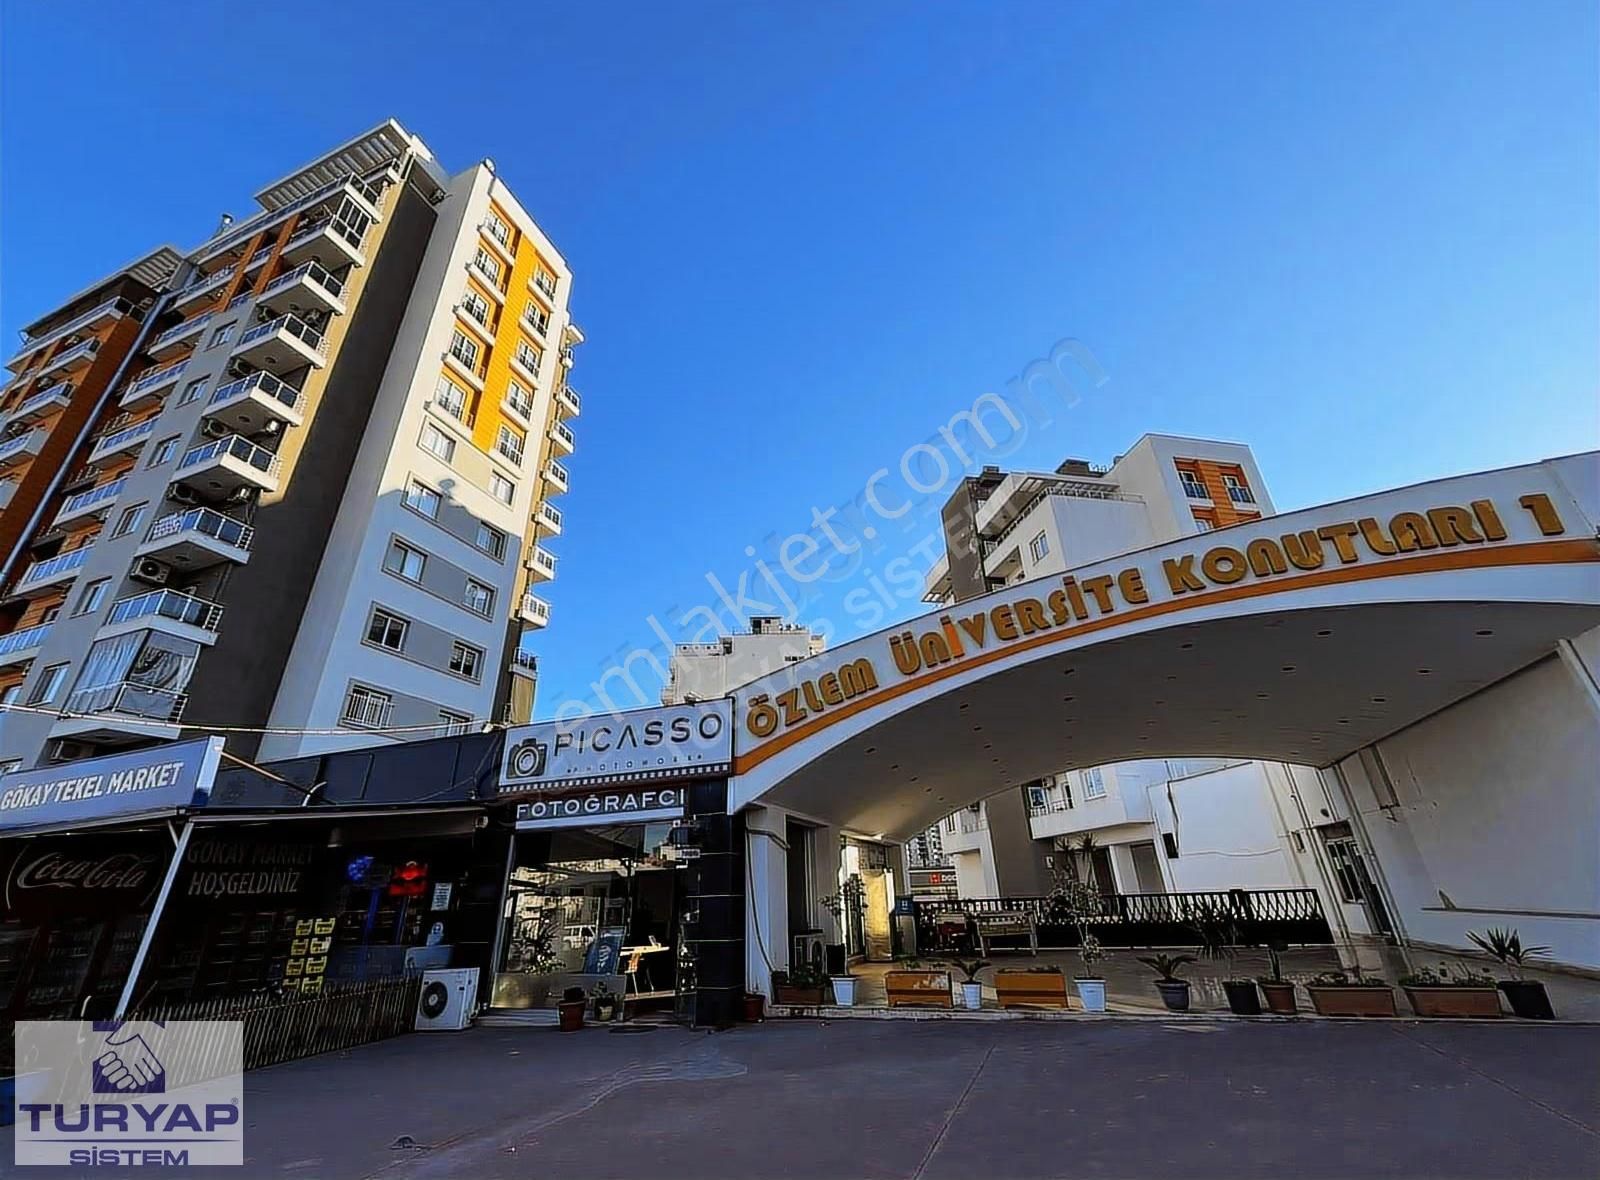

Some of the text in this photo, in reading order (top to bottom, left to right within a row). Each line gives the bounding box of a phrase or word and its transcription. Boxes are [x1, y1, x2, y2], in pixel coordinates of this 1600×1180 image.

[746, 656, 878, 738] ÖZLEM
[1162, 499, 1507, 595] KONUTLARI
[1519, 493, 1566, 536] 1
[553, 712, 723, 757] PICASSO
[1, 762, 184, 810] GÖKAY TEKEL MARKET
